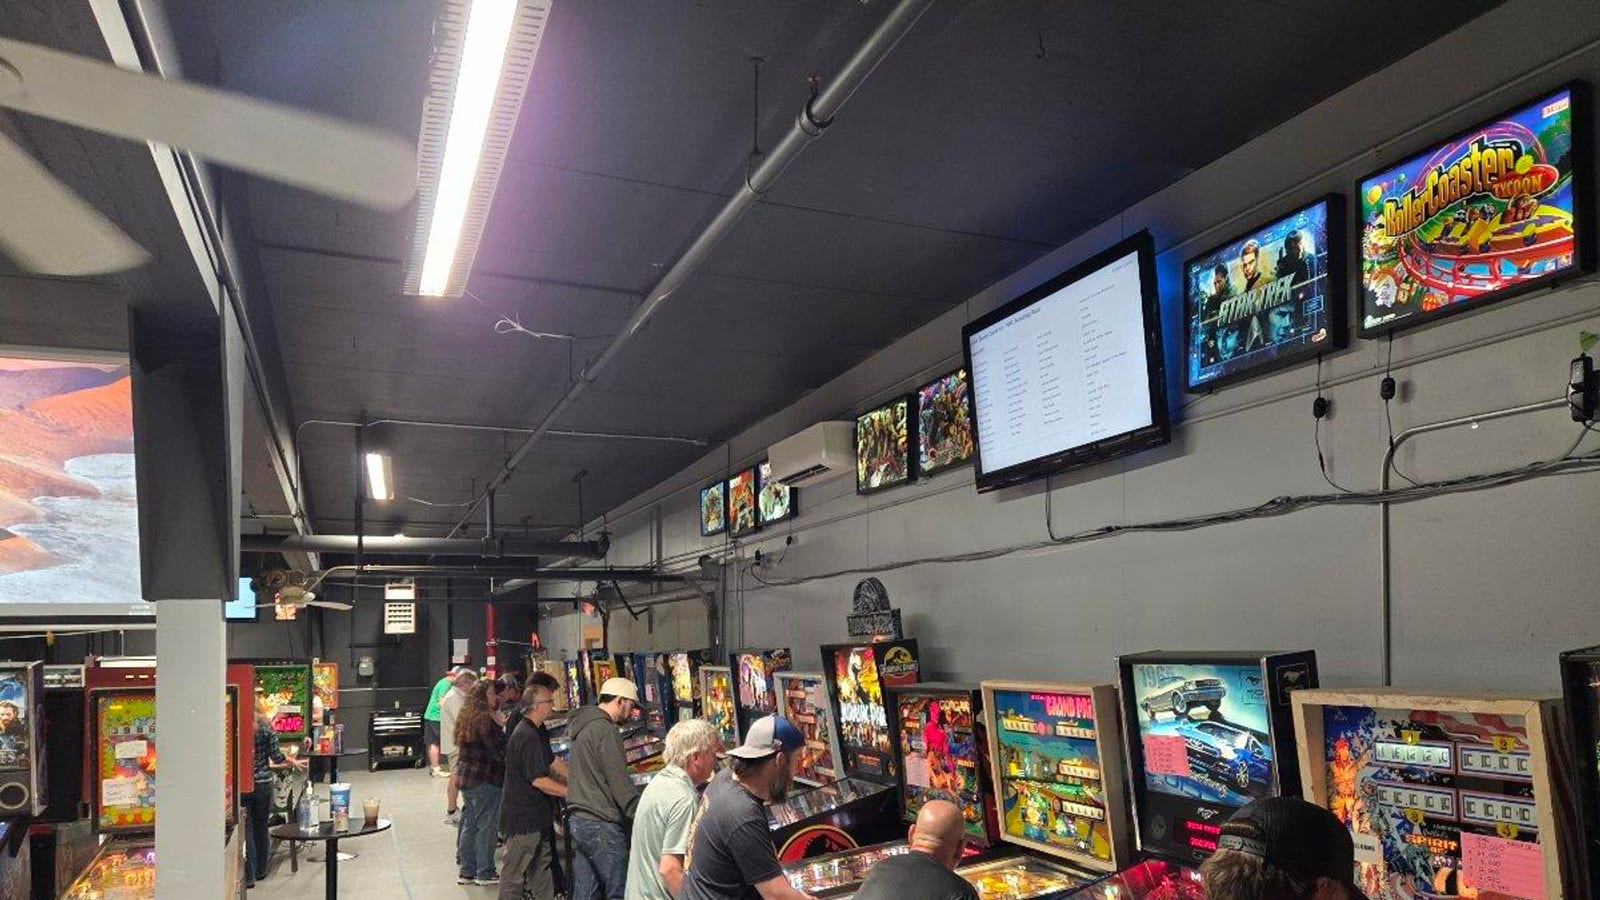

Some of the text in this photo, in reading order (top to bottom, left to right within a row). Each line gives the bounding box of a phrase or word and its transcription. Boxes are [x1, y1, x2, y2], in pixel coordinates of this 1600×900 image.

[1493, 174, 1543, 197] TYCOON
[1046, 695, 1076, 717] GRAND
[1404, 833, 1458, 850] SPIRIT
